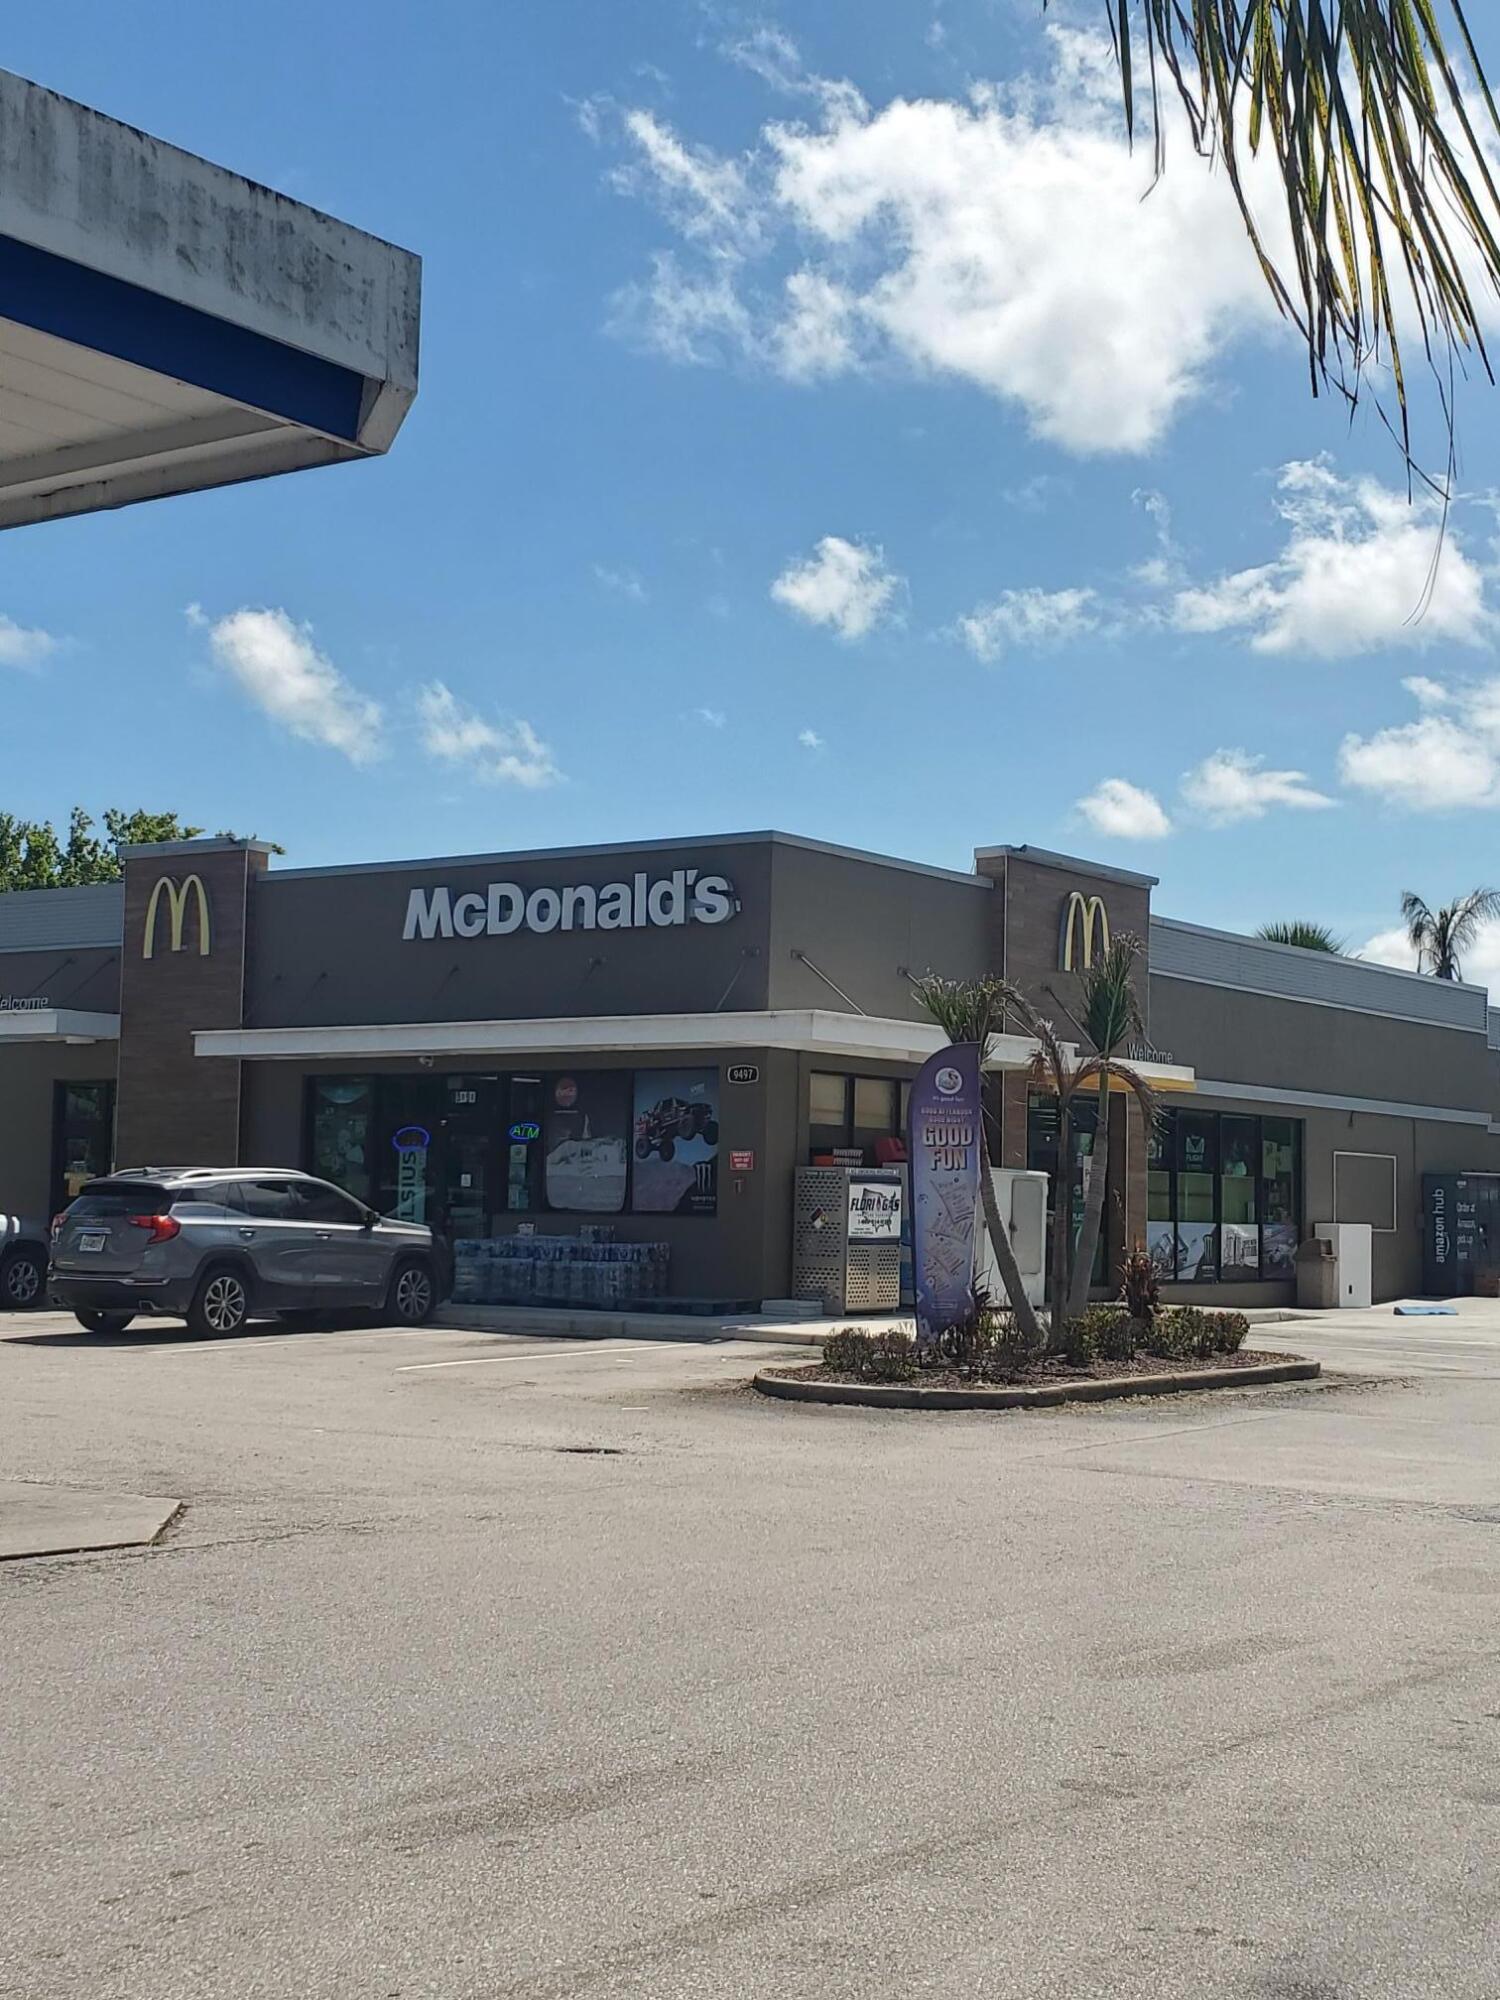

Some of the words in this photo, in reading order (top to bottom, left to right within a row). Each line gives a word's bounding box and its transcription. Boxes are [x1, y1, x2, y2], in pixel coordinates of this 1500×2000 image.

[402, 869, 731, 940] McDonald's
[0, 994, 49, 1010] elcome
[1127, 1041, 1174, 1064] Welcome
[733, 1068, 753, 1081] 9497
[511, 1124, 540, 1139] ATM
[922, 1125, 973, 1147] GOOD
[929, 1148, 969, 1171] FUN
[850, 1197, 875, 1212] FLORI
[881, 1197, 901, 1212] GAS
[1432, 1188, 1445, 1214] hub
[1435, 1216, 1446, 1264] amazon
